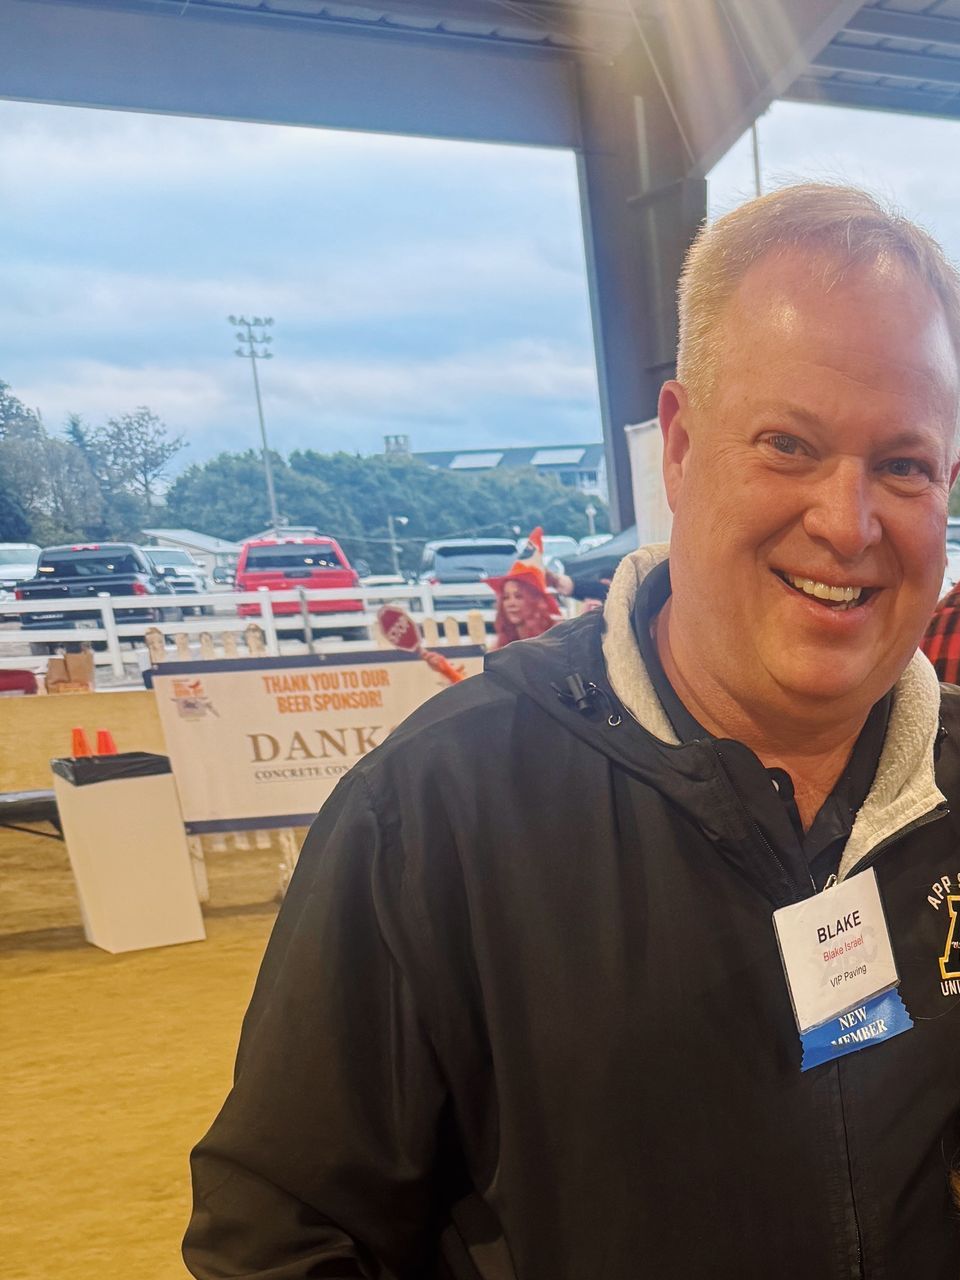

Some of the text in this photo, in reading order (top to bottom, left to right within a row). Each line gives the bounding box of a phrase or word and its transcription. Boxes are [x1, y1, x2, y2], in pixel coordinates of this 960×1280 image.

[262, 668, 390, 694] THANK YOU TO OUR
[276, 690, 383, 714] BEER SPONSOR!
[246, 724, 396, 762] DANK
[255, 766, 320, 780] CONCRETE
[927, 874, 952, 911] APP
[816, 910, 862, 944] BLAKE
[823, 935, 864, 962] Blake Israel
[830, 963, 867, 988] VIP Paving
[839, 1007, 868, 1030] NEW
[831, 1019, 888, 1046] MEMBER
